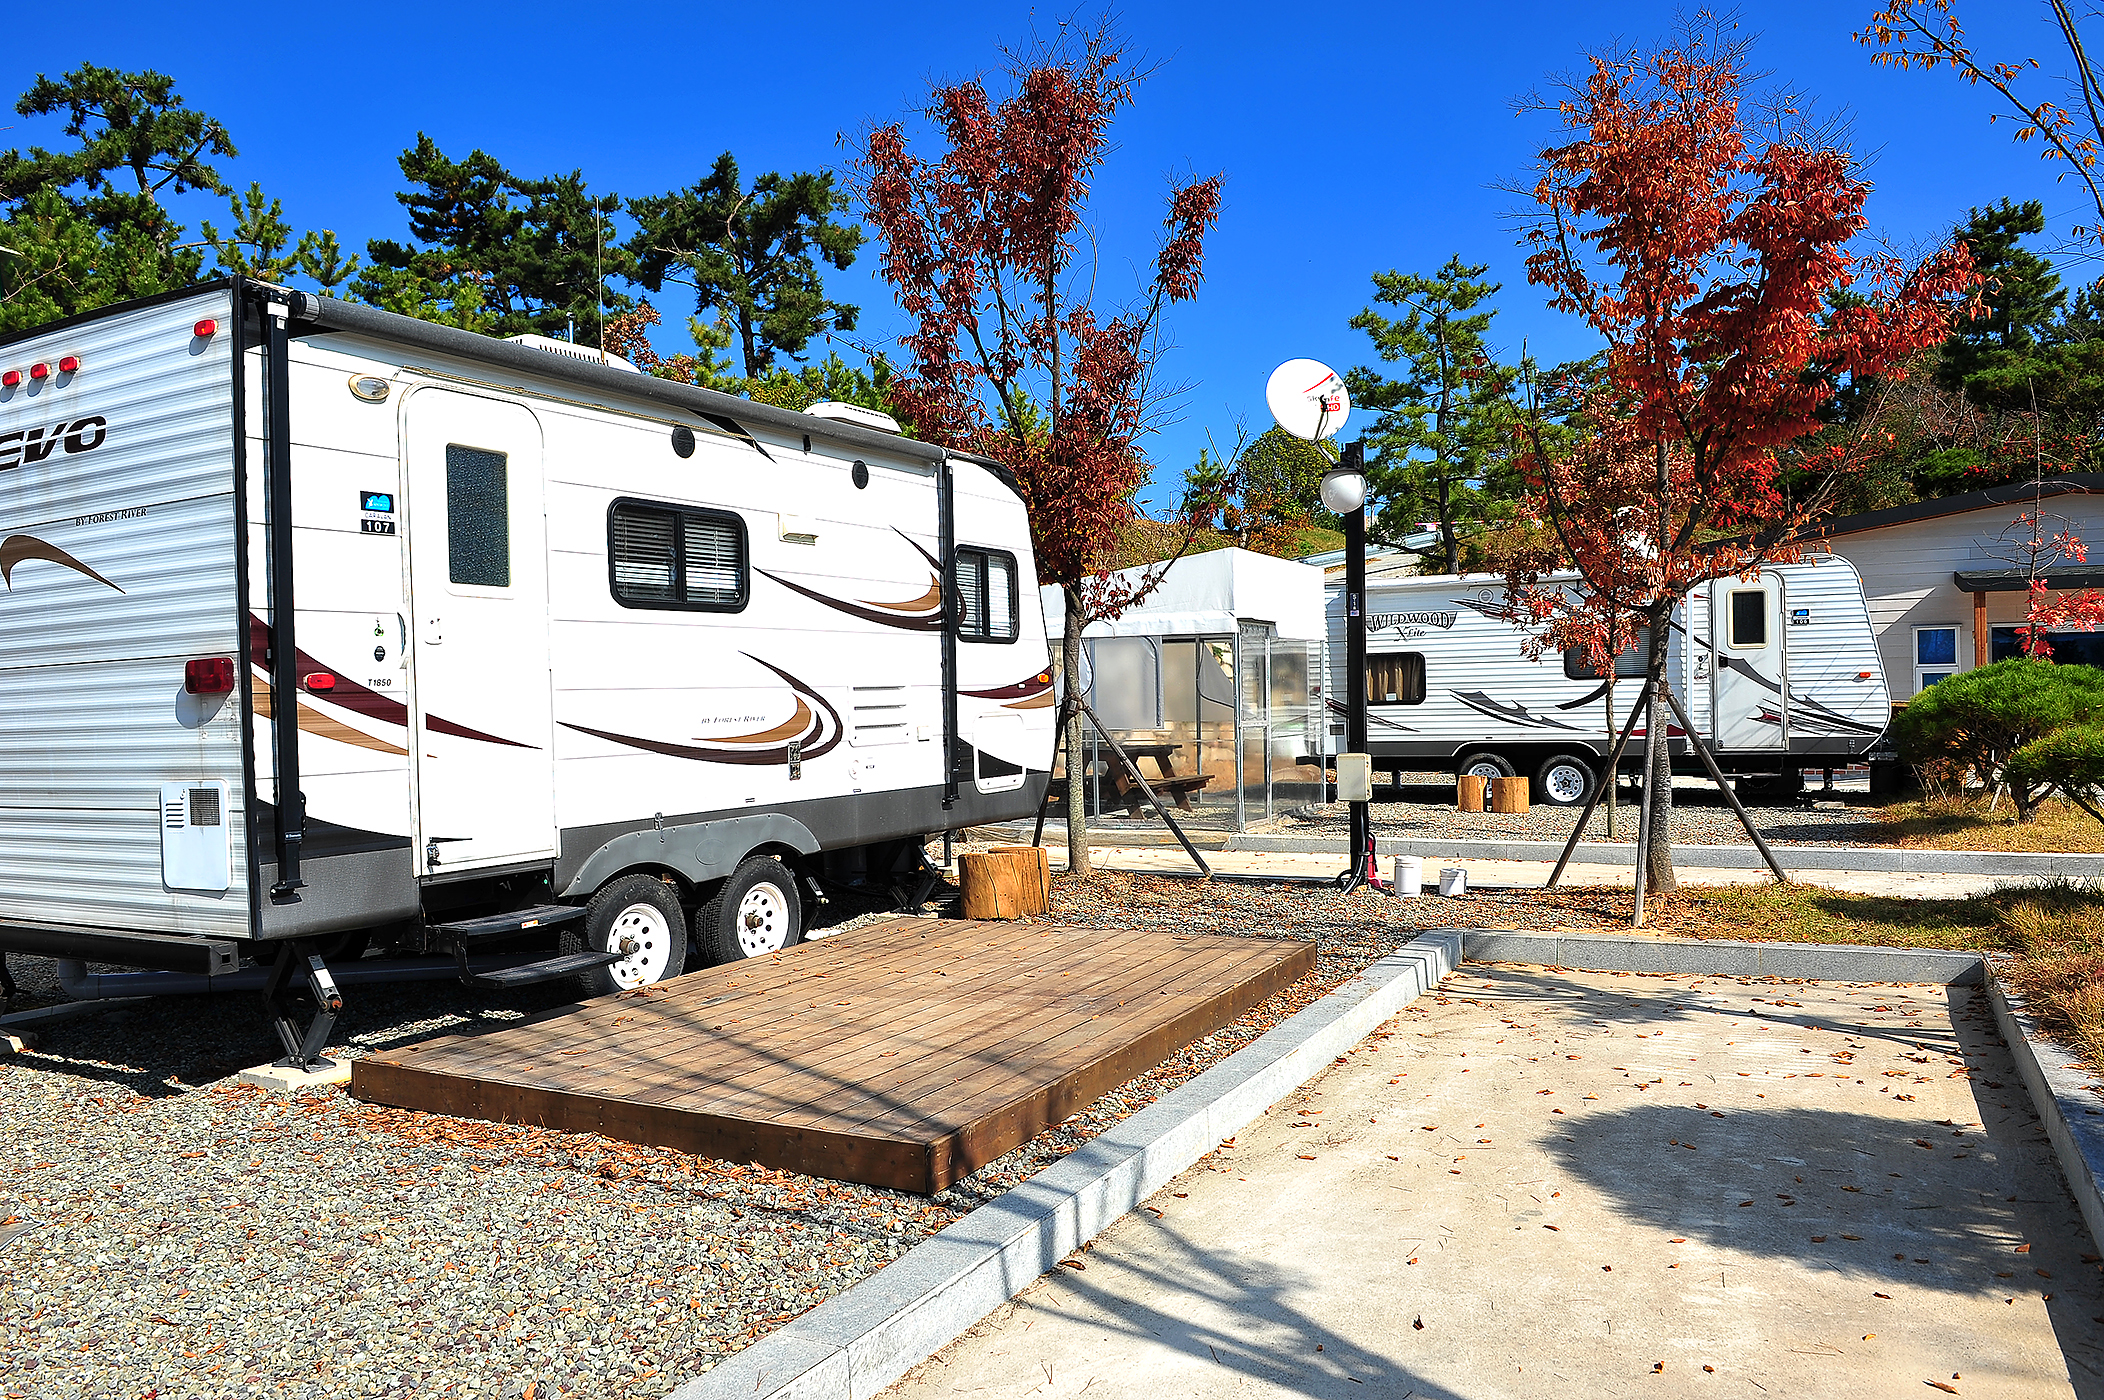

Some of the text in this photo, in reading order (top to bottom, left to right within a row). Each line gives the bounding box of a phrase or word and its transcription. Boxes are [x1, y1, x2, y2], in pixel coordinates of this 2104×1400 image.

[1327, 403, 1340, 411] HD
[0, 416, 107, 471] EVO
[75, 507, 147, 526] BY FOREST RIVER
[366, 521, 390, 533] 107
[1371, 611, 1450, 632] WILDWOOD
[1390, 626, 1427, 642] X-Lite
[368, 678, 392, 687] T1850
